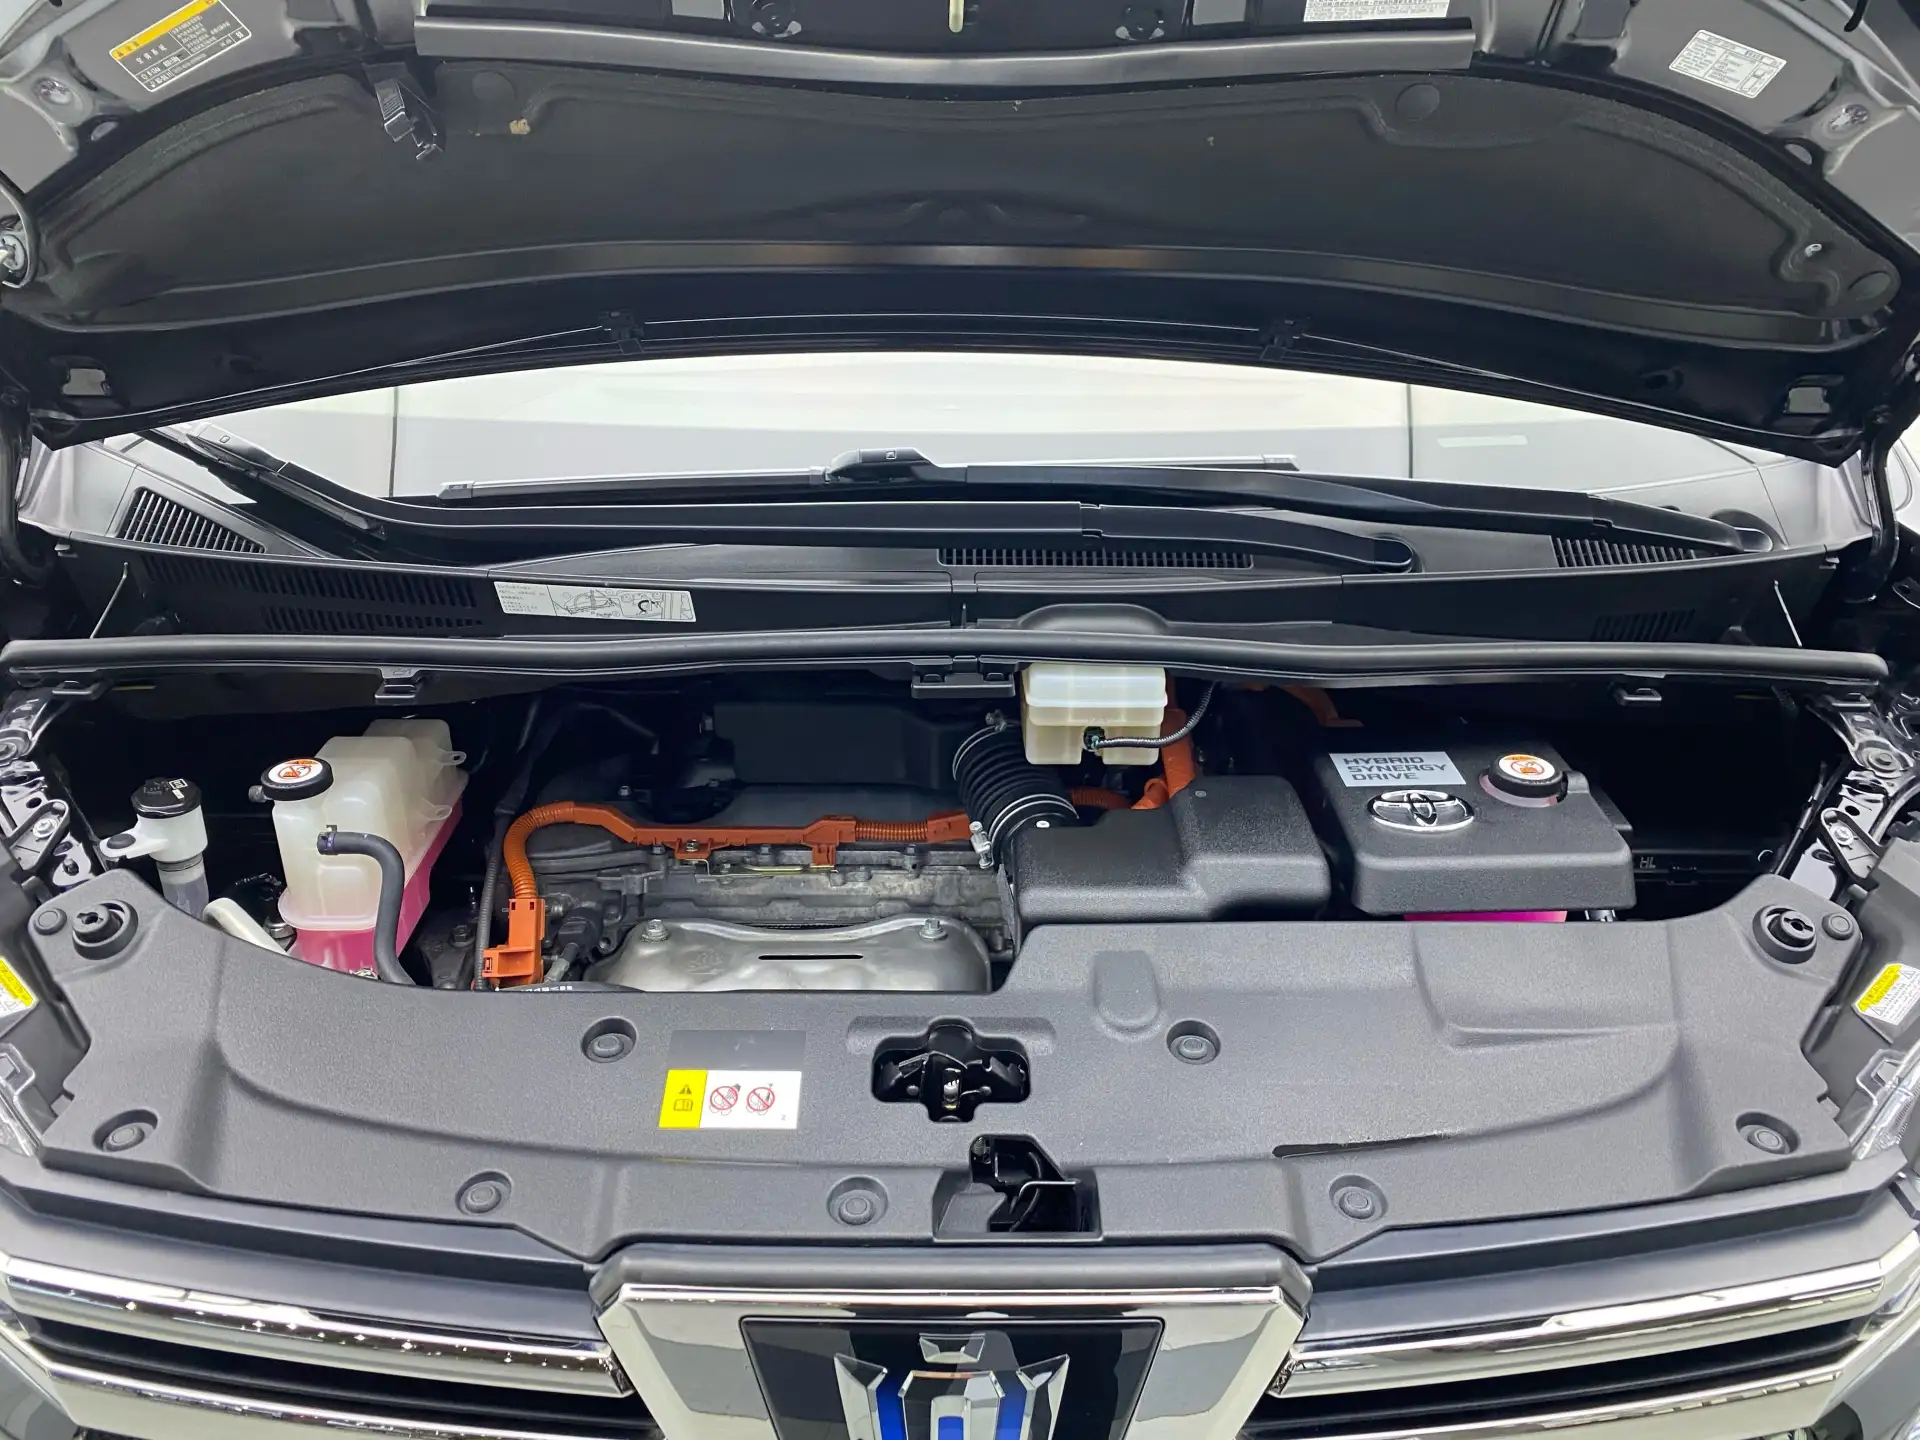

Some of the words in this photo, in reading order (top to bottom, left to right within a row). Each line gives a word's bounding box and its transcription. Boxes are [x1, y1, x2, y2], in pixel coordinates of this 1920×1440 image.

[1343, 756, 1425, 765] HYBRID
[1347, 764, 1447, 773] SYNERGY
[1351, 772, 1419, 781] DRIVE
